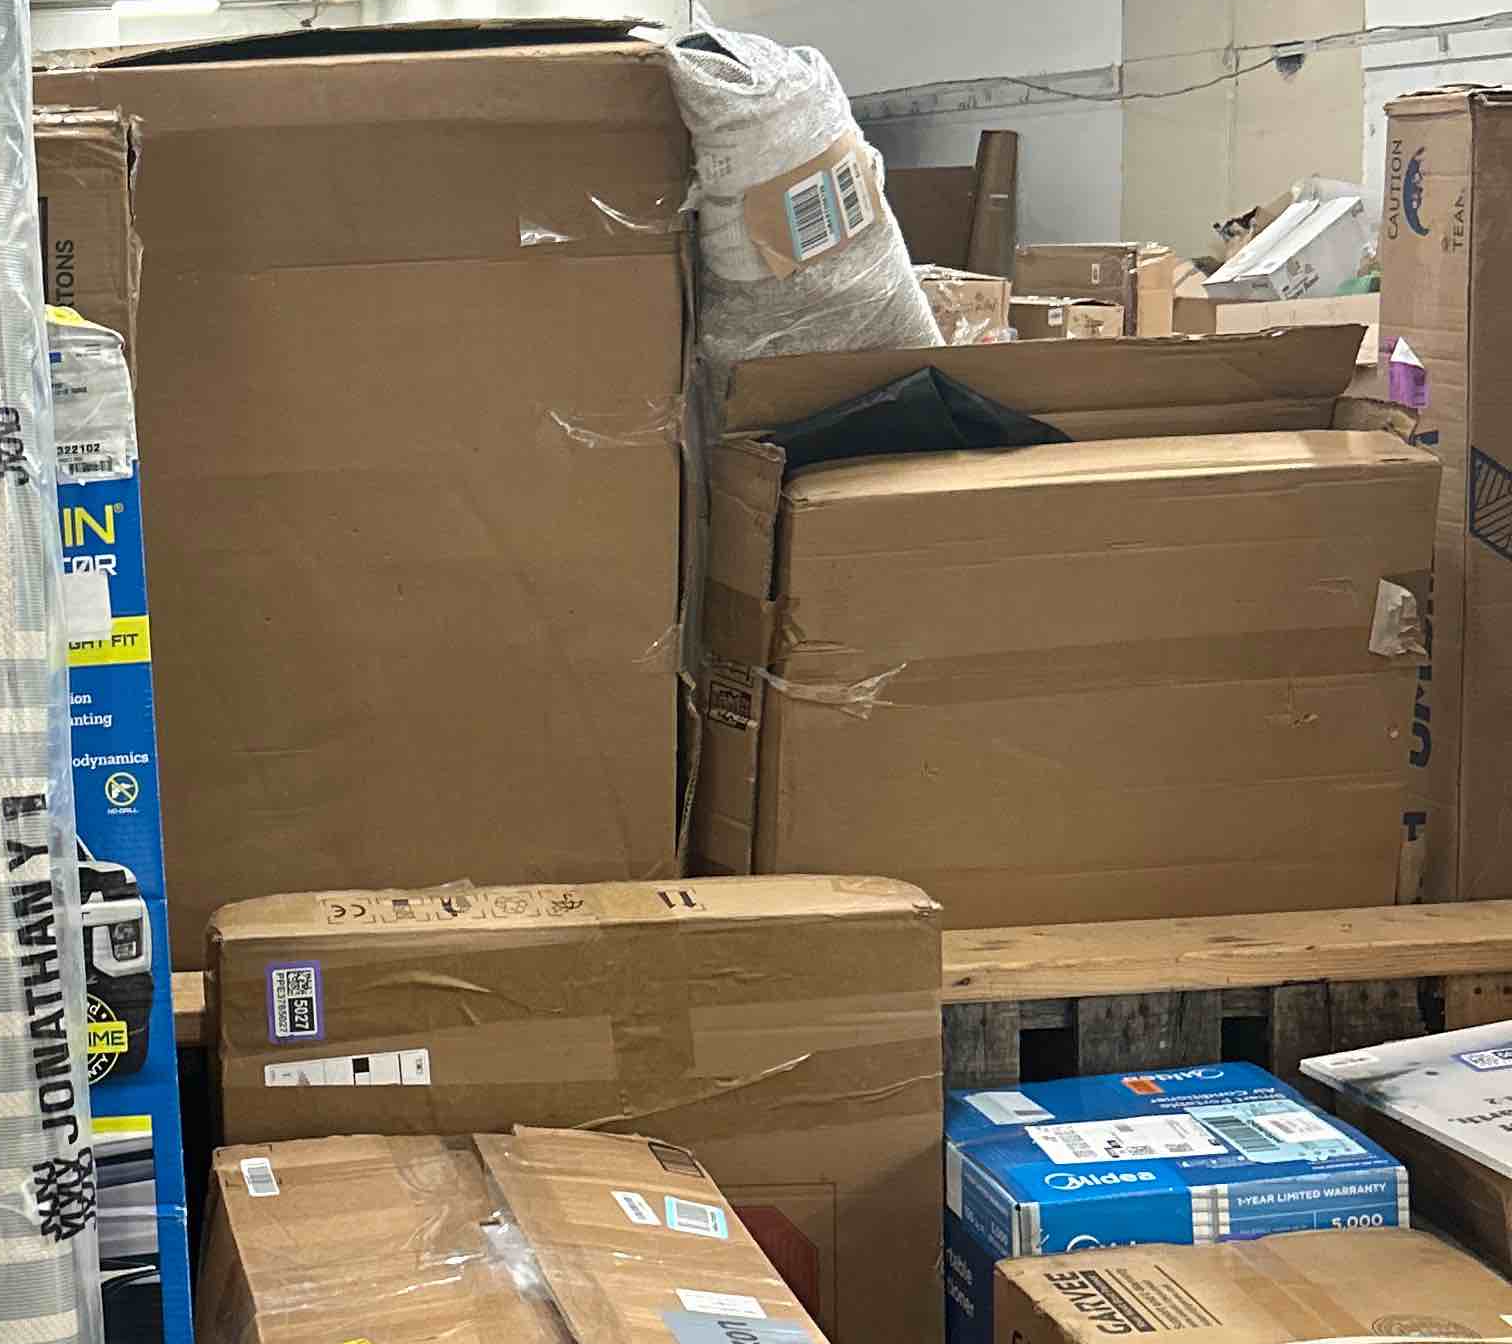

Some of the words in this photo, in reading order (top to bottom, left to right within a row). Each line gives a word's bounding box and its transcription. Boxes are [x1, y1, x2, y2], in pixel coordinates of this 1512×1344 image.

[1386, 139, 1403, 240] CAUTION
[112, 632, 139, 648] FIT
[8, 839, 51, 873] Y
[10, 881, 81, 1145] JONATHAN
[293, 998, 310, 1031] 5027
[1045, 1170, 1157, 1191] Midea
[1236, 1193, 1275, 1208] 1-YEAR
[1277, 1189, 1321, 1203] LIMITED
[1323, 1182, 1387, 1198] WARRANTY
[1043, 1270, 1133, 1335] GARVEE
